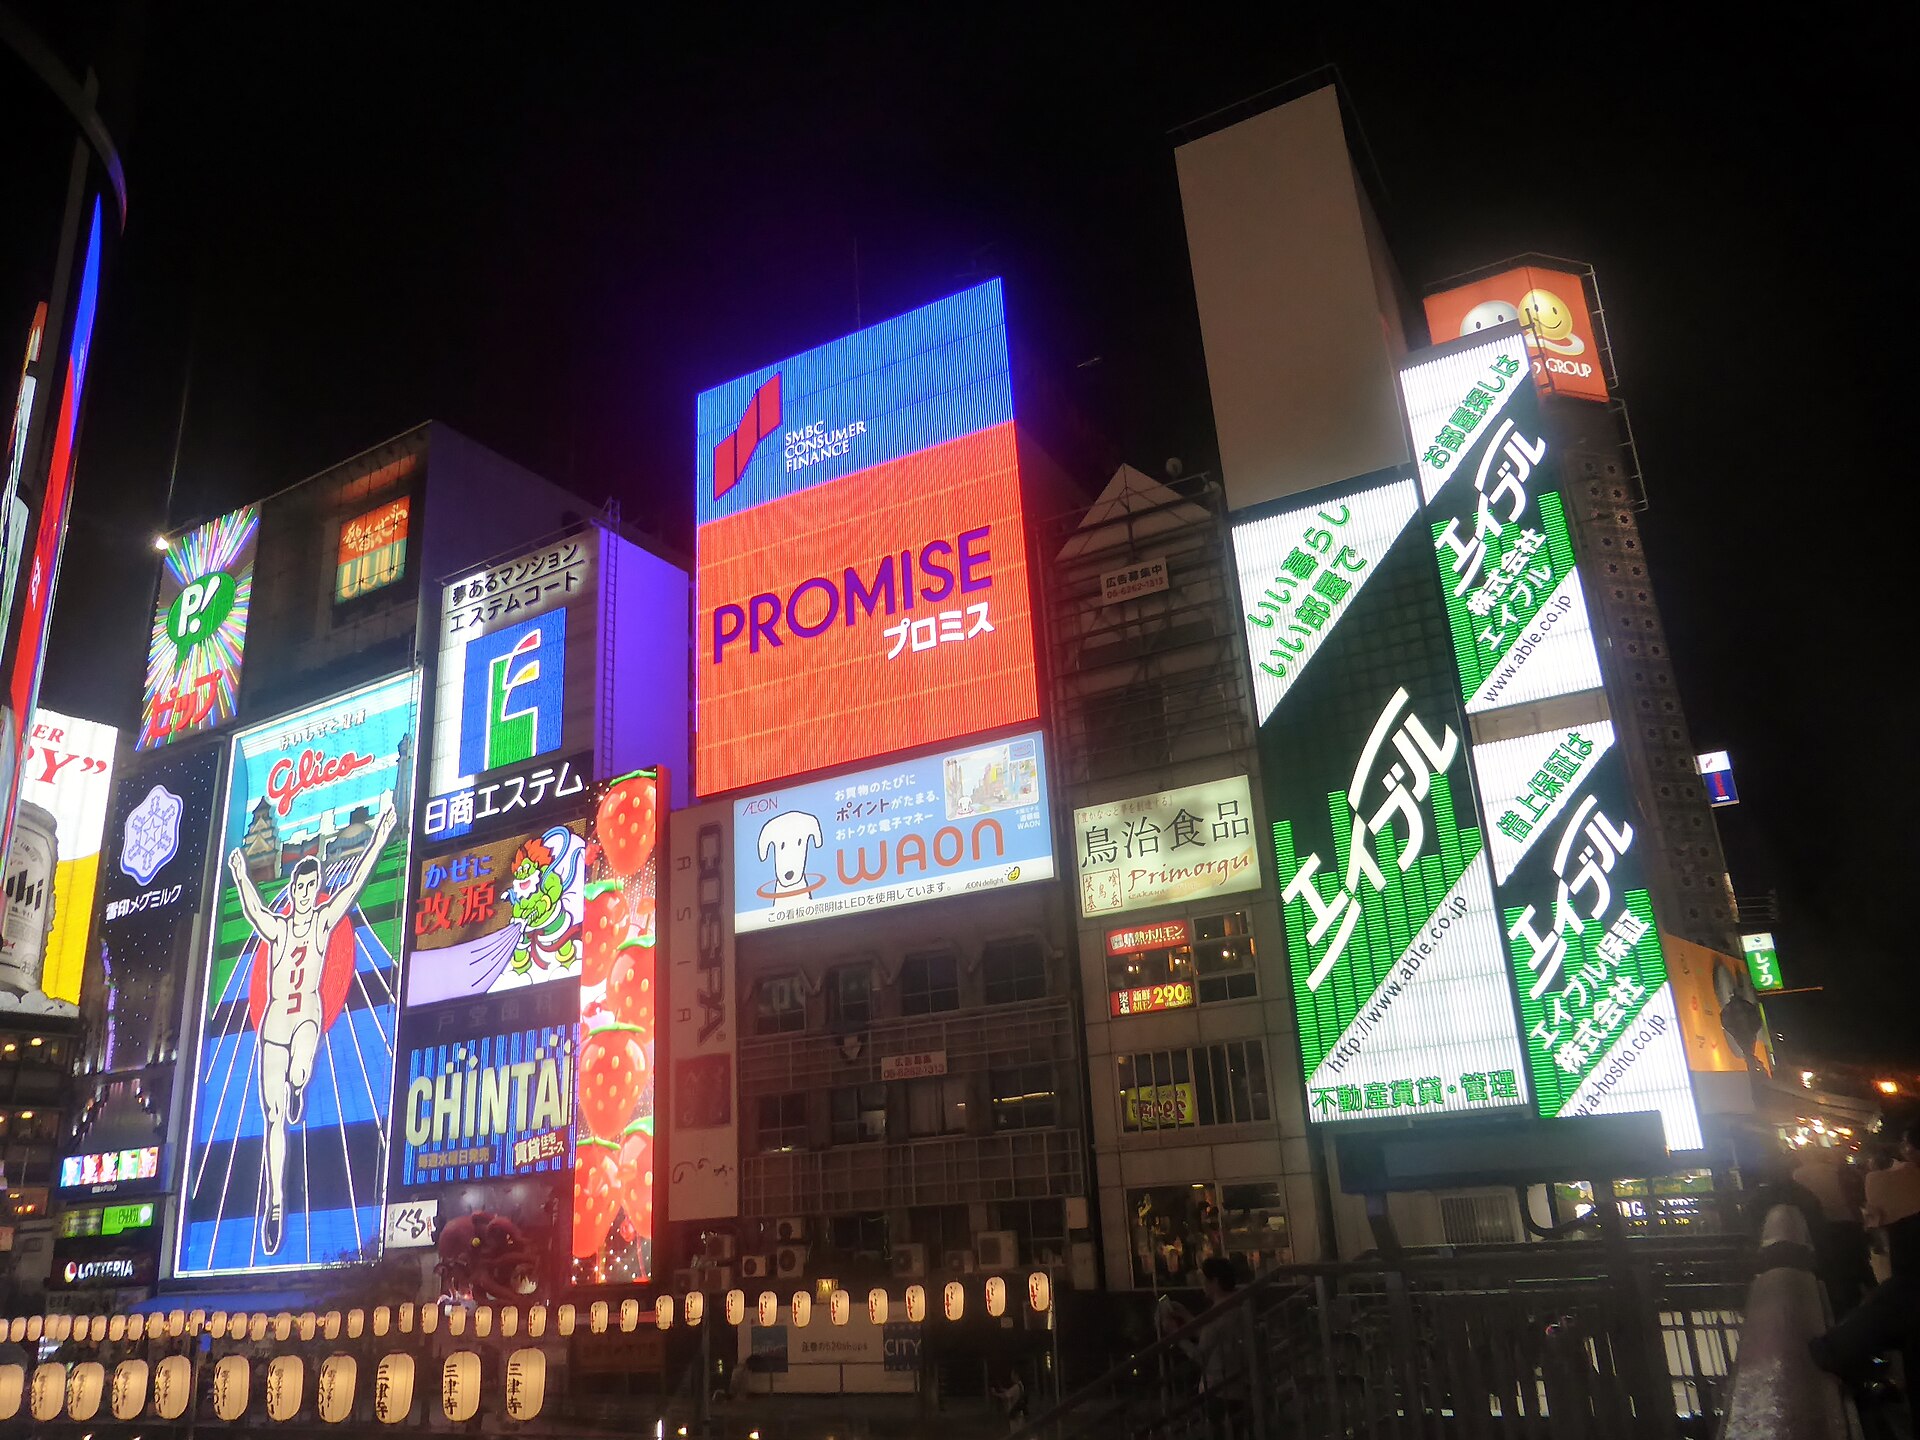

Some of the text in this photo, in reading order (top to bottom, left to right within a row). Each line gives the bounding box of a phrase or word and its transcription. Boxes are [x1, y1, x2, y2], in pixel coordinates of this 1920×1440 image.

[1545, 358, 1592, 378] GROUP
[784, 421, 867, 458] CONSUMER
[785, 421, 825, 446] SMBC
[1423, 355, 1520, 469] お部屋探しは
[786, 440, 850, 473] FINANCE
[1435, 418, 1546, 597] エイブル
[453, 544, 578, 606] 夢あるマンション
[714, 525, 993, 664] PROMISE
[1247, 505, 1350, 628] いい暮らし
[1465, 528, 1546, 618] 株式会社
[178, 577, 221, 637] P!
[450, 571, 579, 633] エステムコート
[884, 602, 995, 660] プロミス
[1259, 545, 1367, 677] いい部屋で
[1477, 563, 1553, 651] エイブル
[1483, 594, 1572, 702] www.able.co.jp
[148, 668, 222, 740] ピップ
[267, 749, 374, 816] Glico
[424, 761, 585, 834] 日商エステム
[834, 773, 916, 801] お買物のたびに
[1497, 731, 1595, 843] 借上保証は
[835, 812, 934, 841] おトクな電子マネー
[836, 818, 1004, 886] WAON
[1017, 820, 1040, 830] WAON
[1082, 800, 1249, 868] 鳥治食品
[1281, 686, 1458, 993] エイブル
[106, 884, 183, 921] 雪印メグミルク
[424, 853, 493, 889] かぜに
[768, 881, 952, 922] この看板の照明はLEDを使用しています。
[1507, 794, 1633, 999] エイブル
[415, 877, 497, 936] 改源
[286, 940, 308, 1015] グリコ
[1153, 984, 1185, 1003] 290
[1327, 895, 1468, 1073] http://www.able.co.jp
[1531, 909, 1650, 1050] エイブル保証
[1755, 952, 1774, 986] レイク
[1553, 975, 1646, 1074] 株式会社
[405, 1034, 573, 1147] CHINTAI
[1311, 1069, 1518, 1115] 不動産賃貸・管理
[541, 1142, 564, 1156] ニュース
[78, 1260, 133, 1279] LOTTERIA
[884, 1339, 922, 1356] CITY
